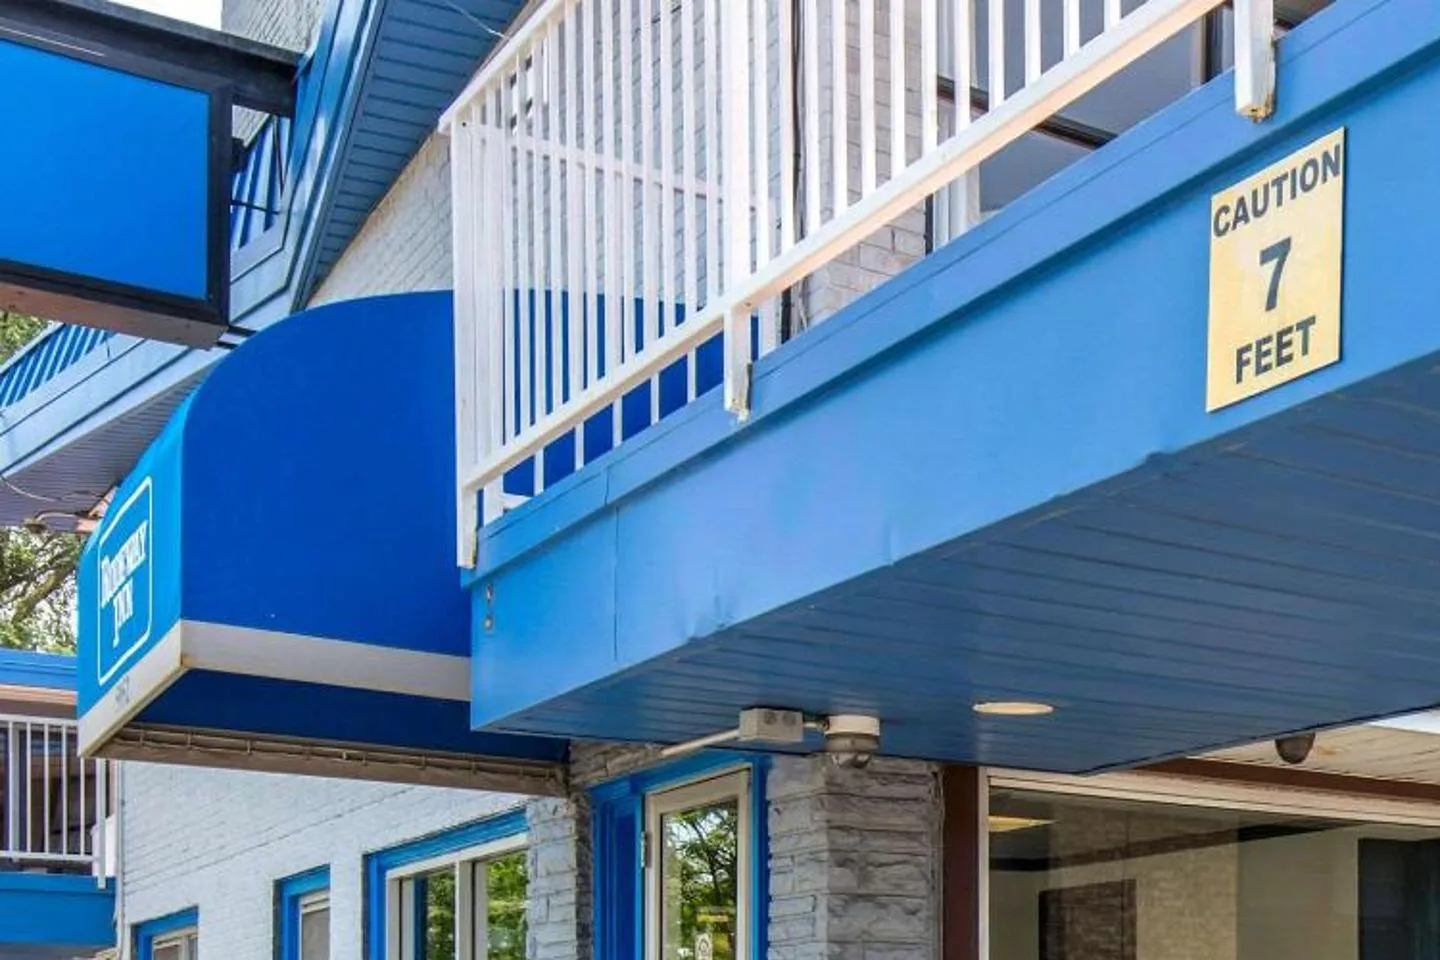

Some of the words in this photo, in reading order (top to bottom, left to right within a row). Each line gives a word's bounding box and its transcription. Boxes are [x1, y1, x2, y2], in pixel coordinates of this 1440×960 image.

[1213, 144, 1341, 237] CAUTION
[1259, 236, 1292, 312] 7
[1235, 315, 1316, 385] FEET
